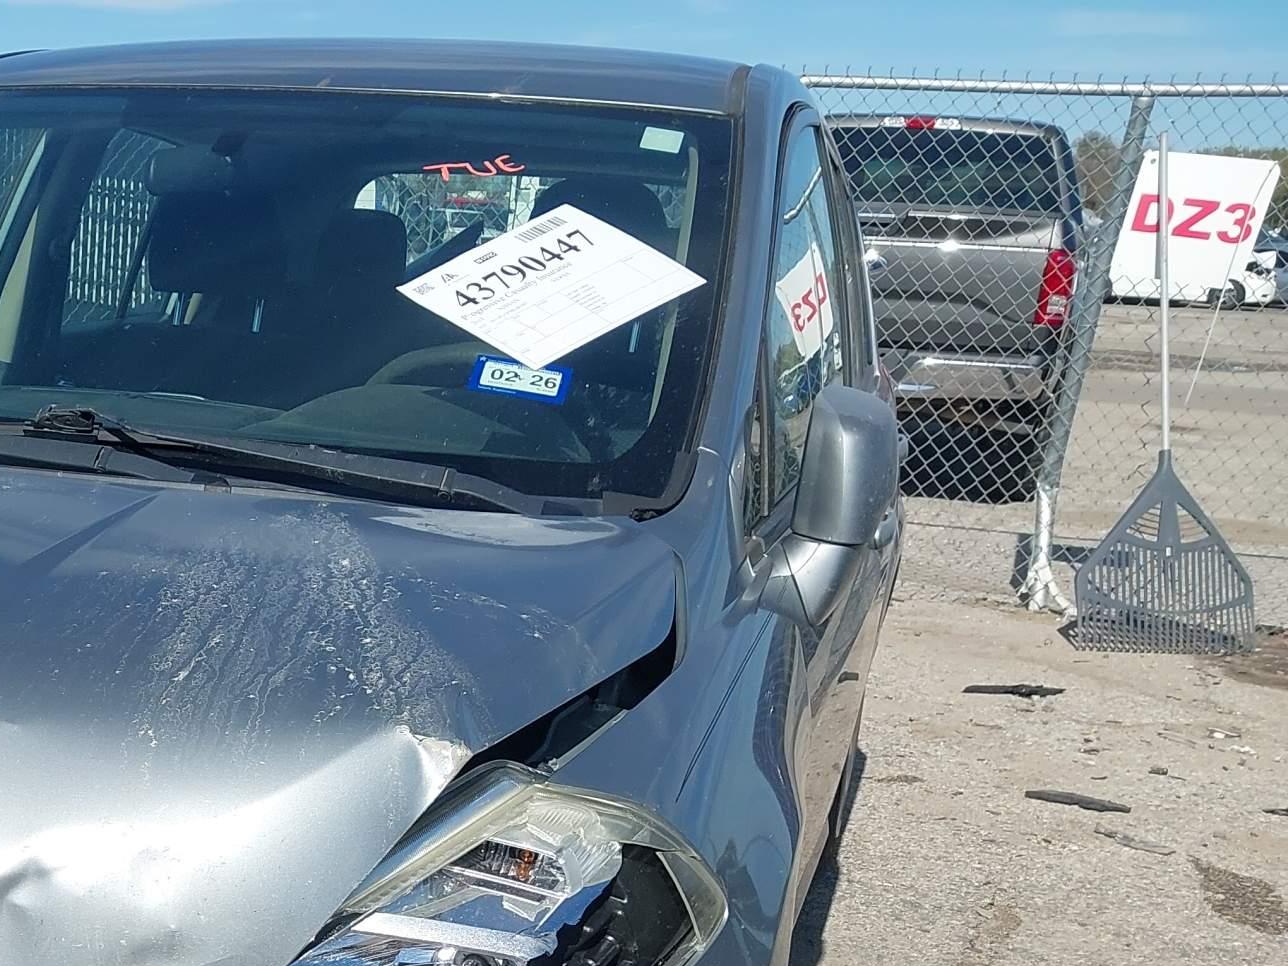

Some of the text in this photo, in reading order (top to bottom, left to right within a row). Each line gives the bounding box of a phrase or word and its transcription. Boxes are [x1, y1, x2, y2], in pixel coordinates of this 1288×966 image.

[422, 154, 525, 182] TUE
[1130, 193, 1256, 245] DZ3
[456, 229, 594, 310] 43790447
[491, 369, 516, 383] 02
[530, 375, 558, 389] 26
